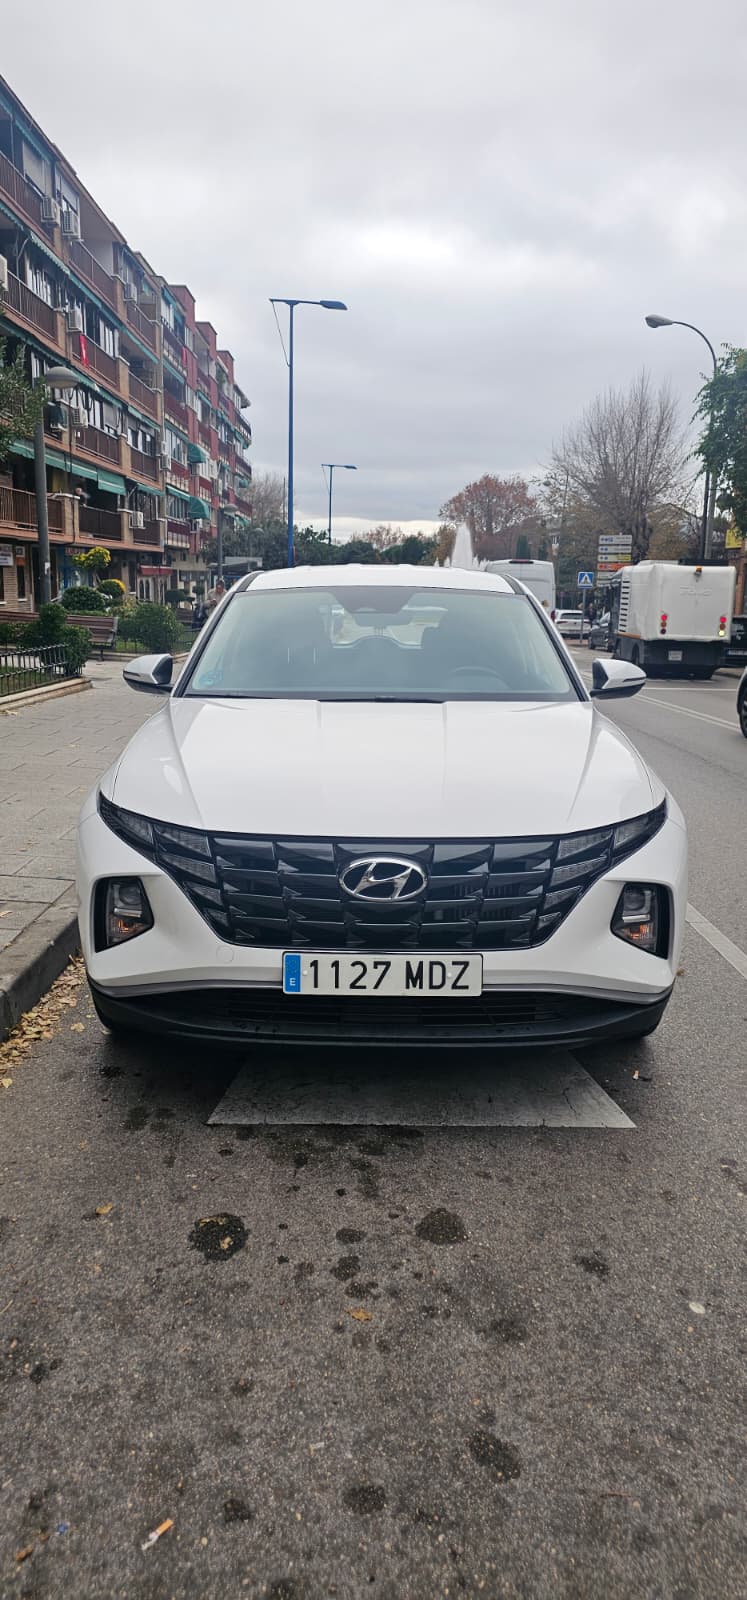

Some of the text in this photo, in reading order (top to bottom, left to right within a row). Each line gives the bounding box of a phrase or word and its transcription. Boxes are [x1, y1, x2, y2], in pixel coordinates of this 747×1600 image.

[289, 977, 297, 986] E
[310, 960, 470, 990] 1127 MDZ
